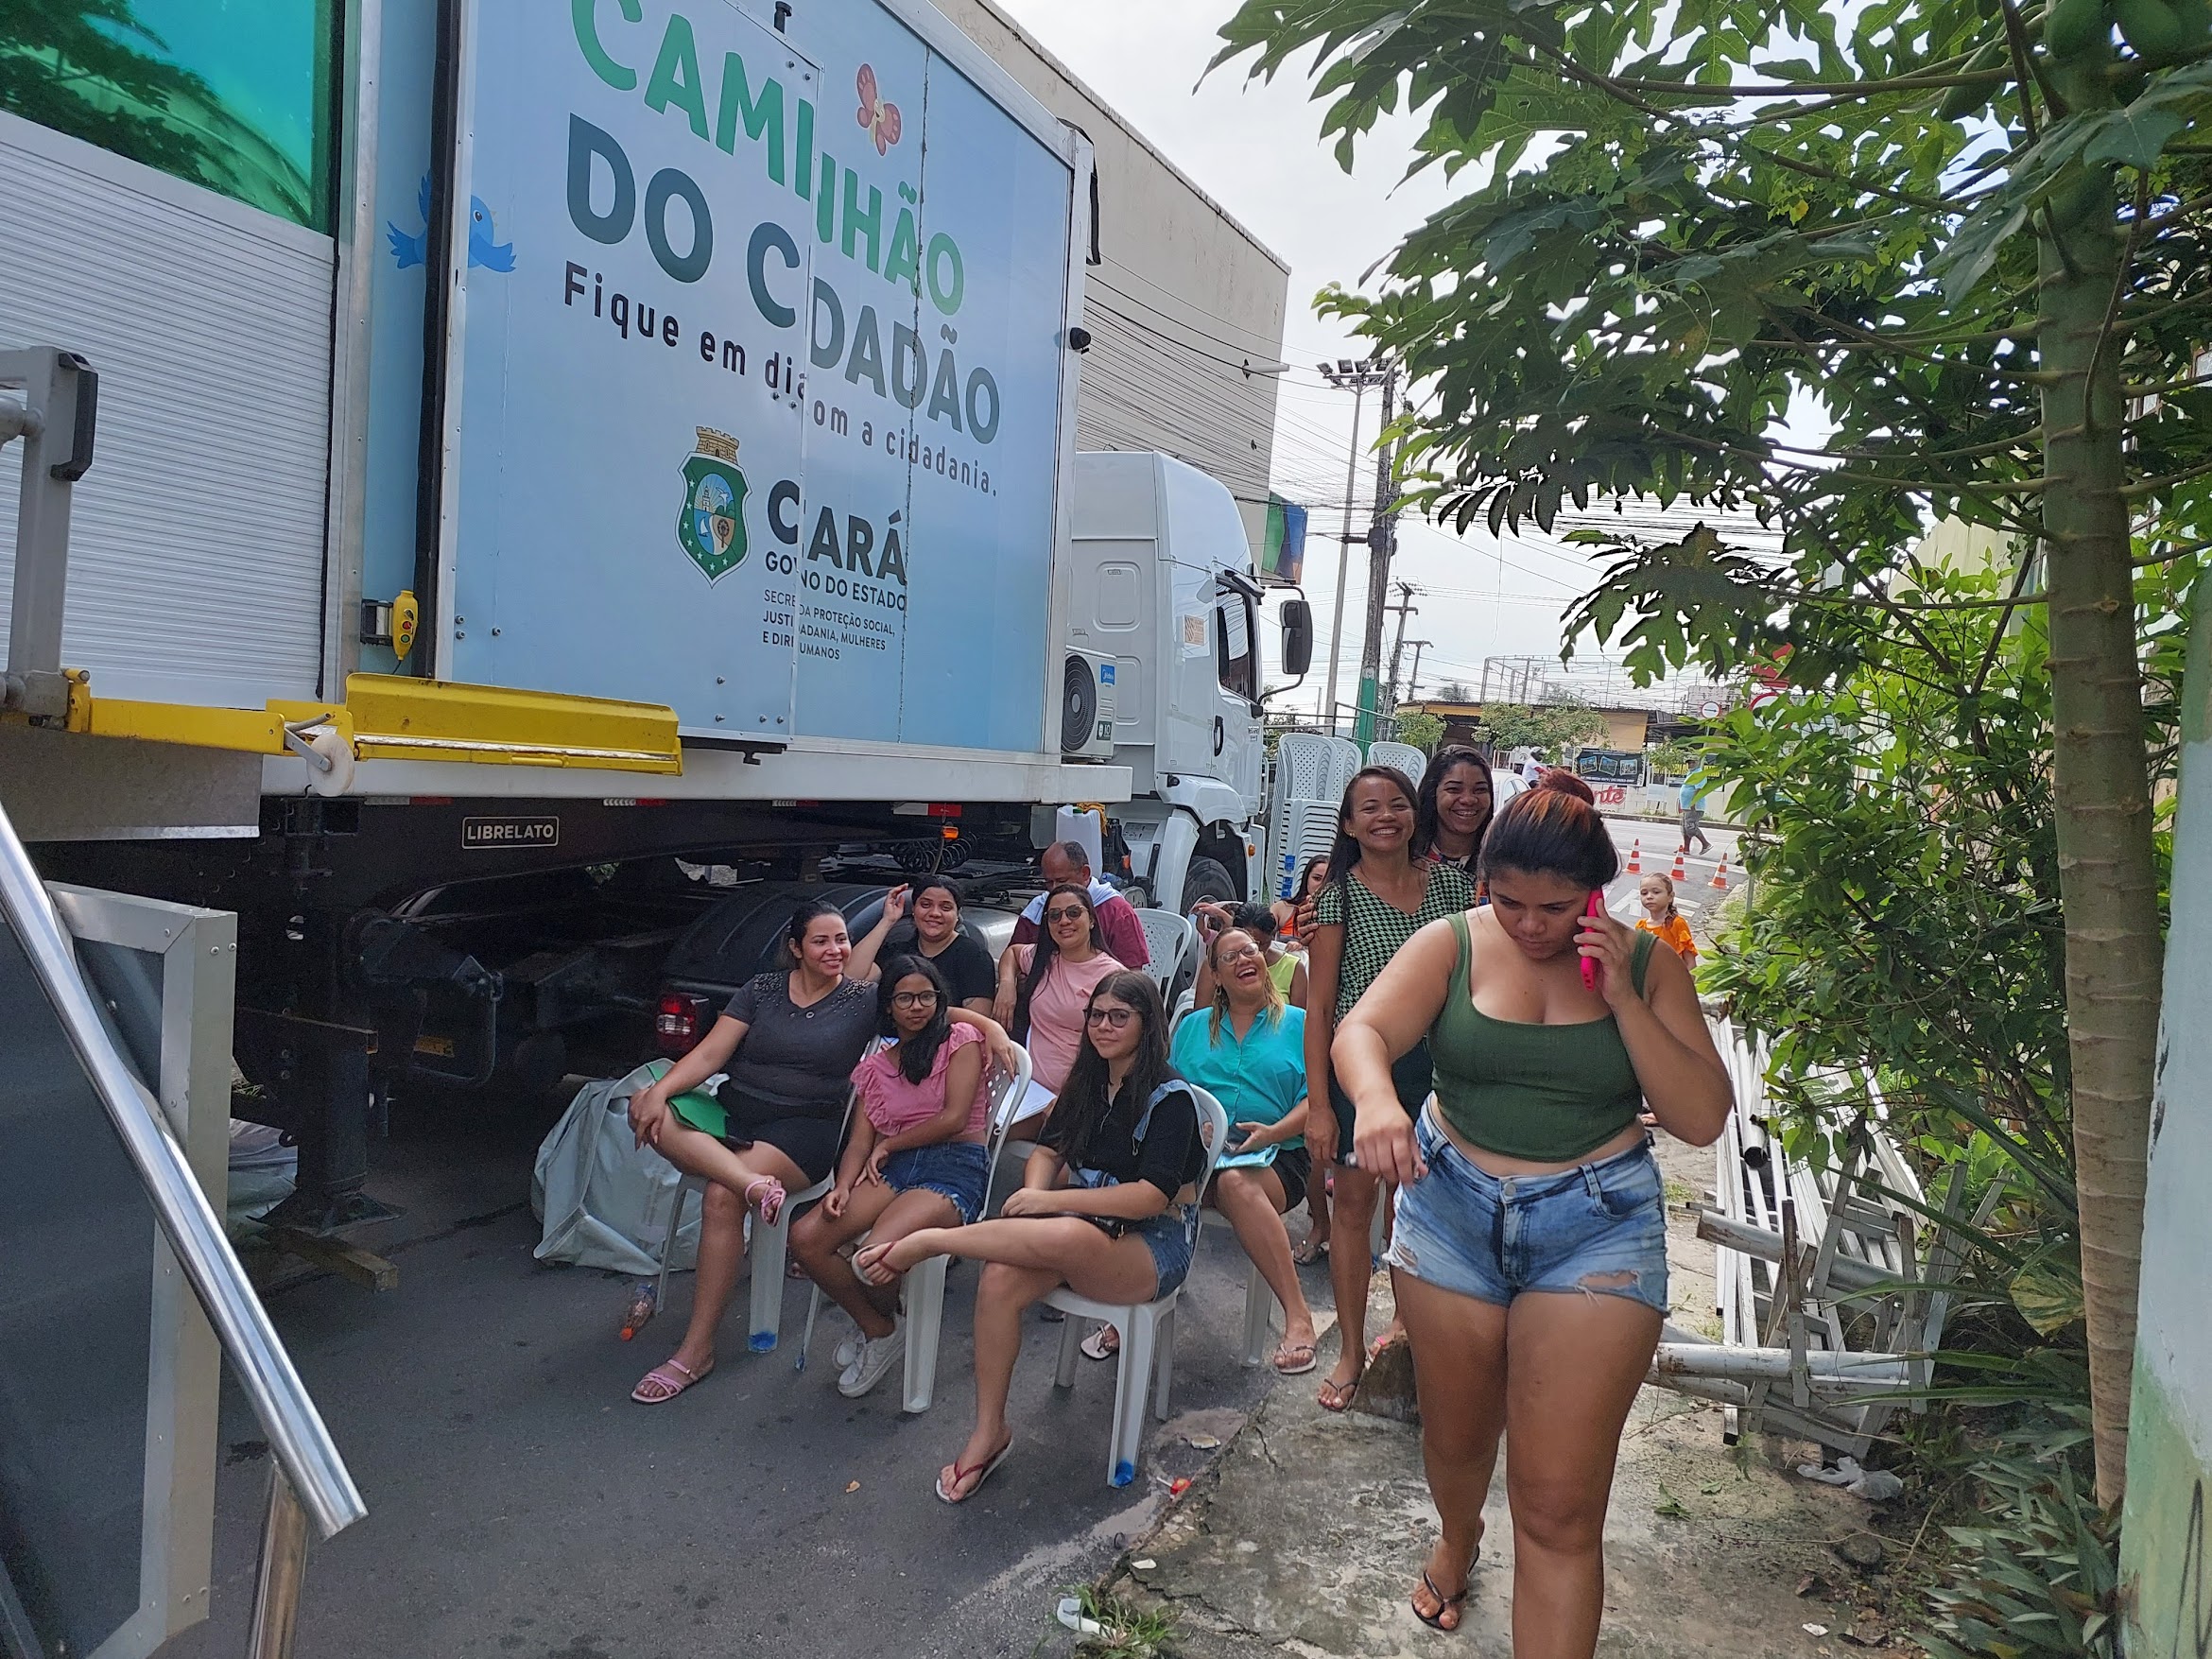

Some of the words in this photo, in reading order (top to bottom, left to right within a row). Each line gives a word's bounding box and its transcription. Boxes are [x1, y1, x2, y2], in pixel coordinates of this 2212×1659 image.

[566, 112, 713, 283] DO
[746, 221, 1000, 444] CDADÃO
[564, 260, 679, 347] Fique
[700, 331, 746, 375] em
[813, 400, 848, 437] om
[861, 421, 873, 446] a
[886, 427, 997, 496] cidadania.
[767, 479, 907, 585] CARÁ
[825, 575, 848, 597] DO
[852, 582, 907, 611] ESTADO
[762, 631, 769, 643] E
[813, 607, 861, 630] PROTEÇÃO
[863, 618, 895, 637] SOCIAL,
[840, 632, 886, 650] MULHERES
[467, 824, 555, 840] LIBRELATO
